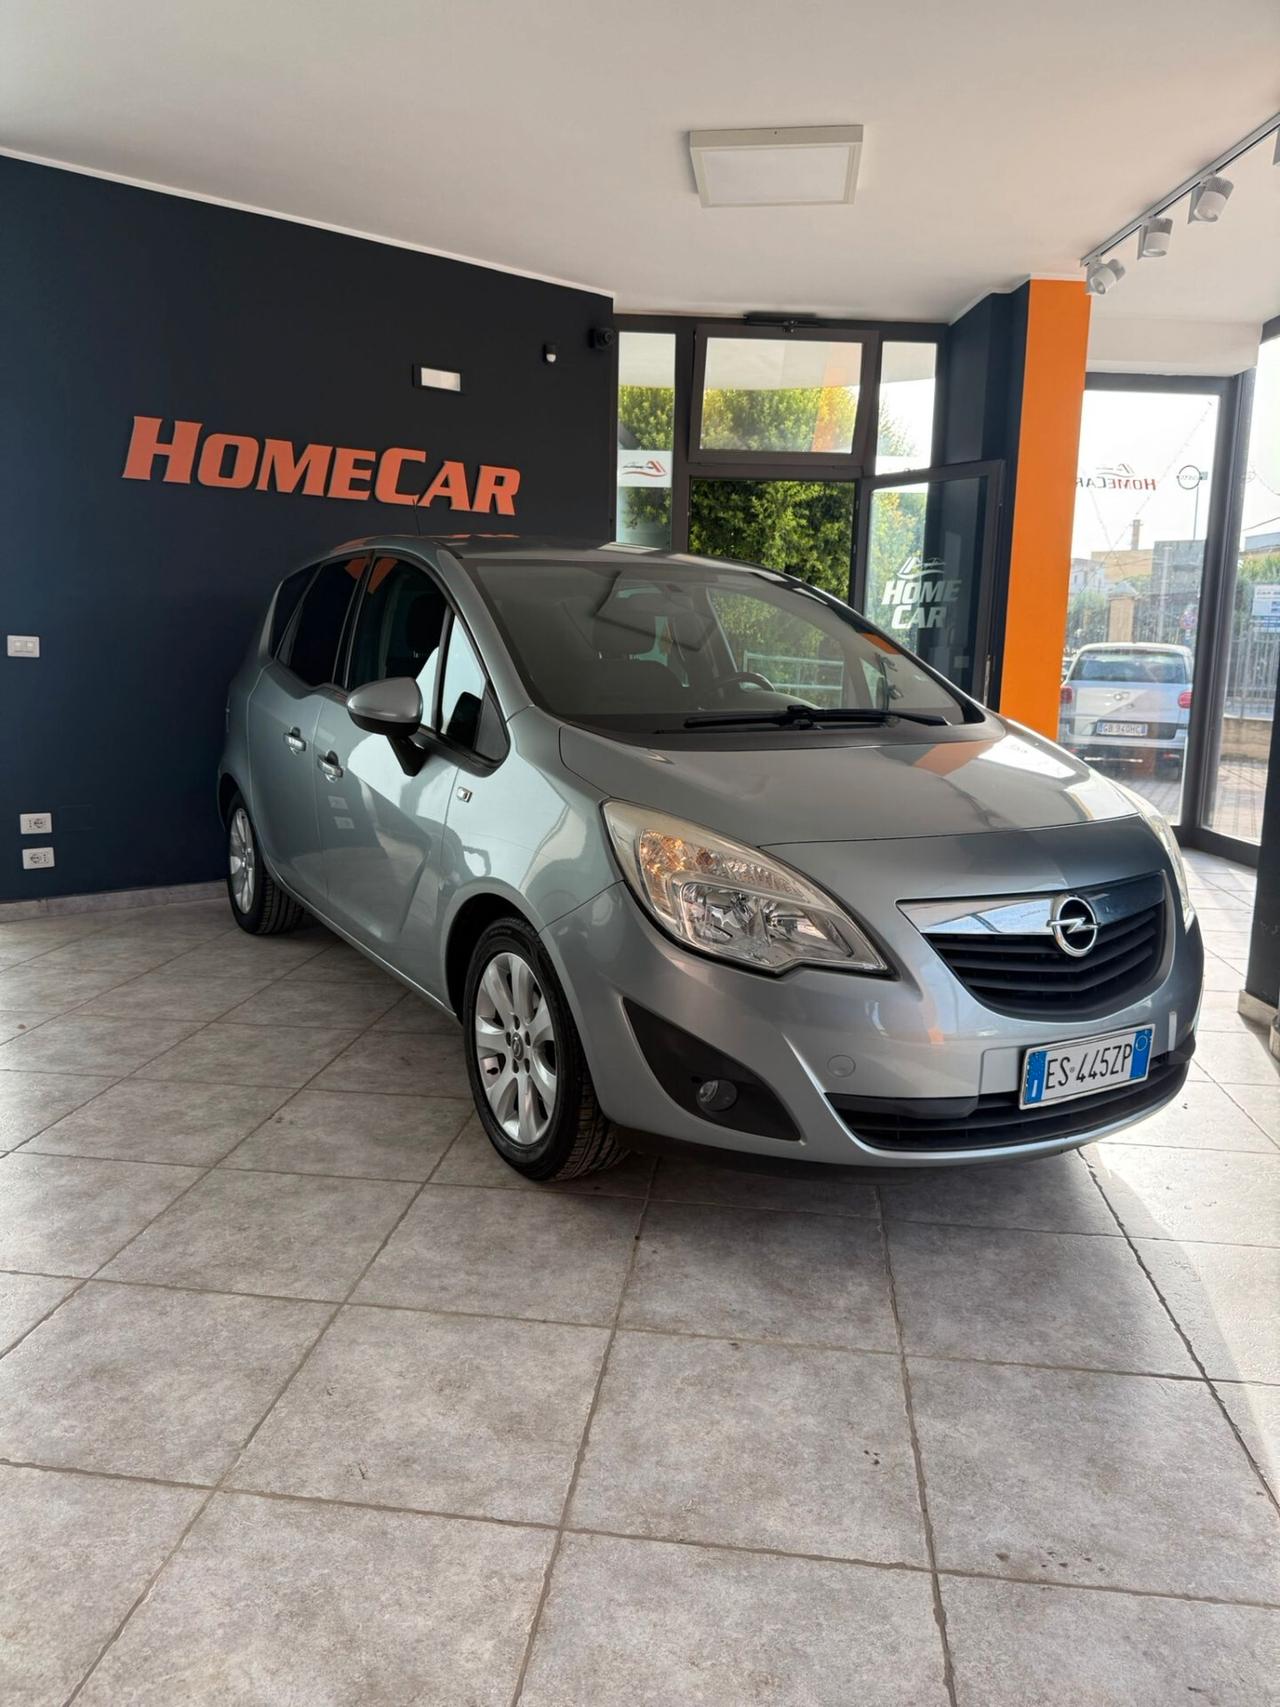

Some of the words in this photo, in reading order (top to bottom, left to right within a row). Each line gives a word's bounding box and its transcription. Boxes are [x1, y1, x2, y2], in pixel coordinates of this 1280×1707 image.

[122, 416, 521, 516] HOMECAR
[881, 580, 962, 605] HOME
[891, 604, 947, 629] CAR
[1045, 1056, 1070, 1089] ES
[1076, 1043, 1132, 1082] 445ZP
